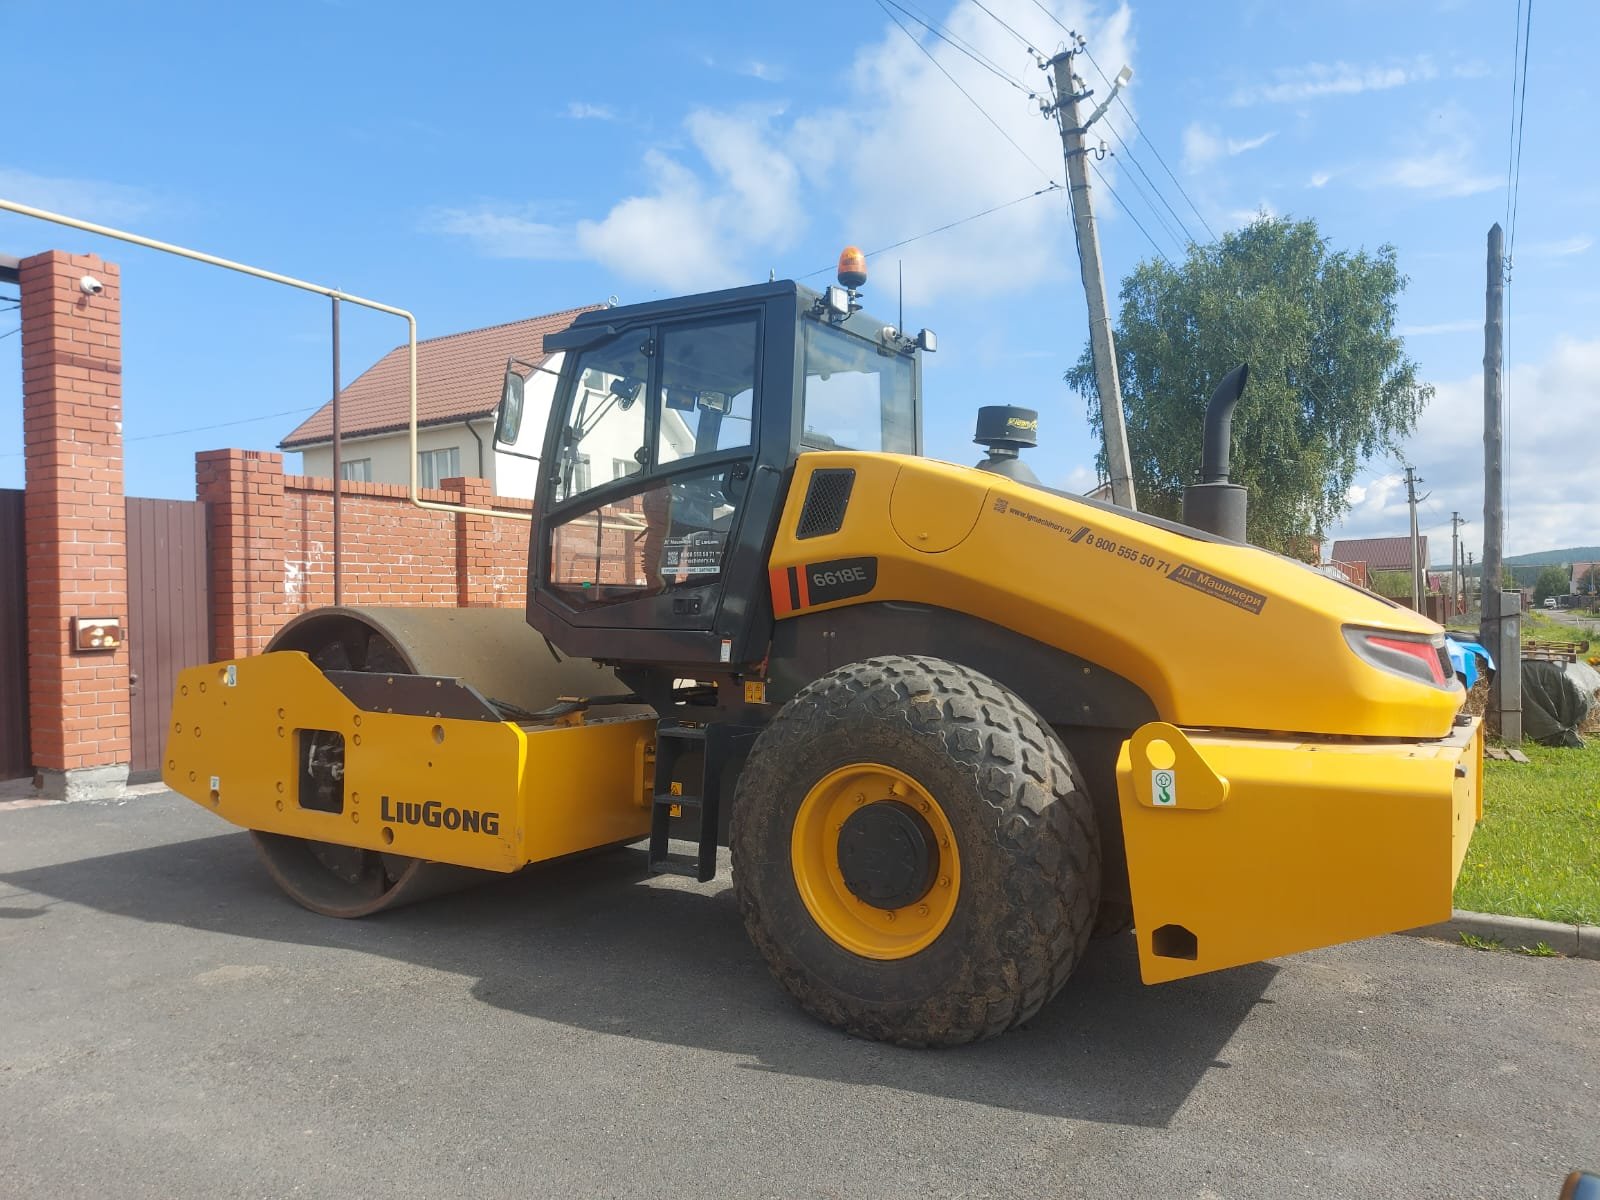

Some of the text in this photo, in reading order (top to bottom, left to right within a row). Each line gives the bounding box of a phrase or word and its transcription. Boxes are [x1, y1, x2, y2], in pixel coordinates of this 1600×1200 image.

[1009, 507, 1073, 535] www.lgmachinery.ru
[1086, 534, 1170, 574] 8 800 555 50 71
[813, 566, 867, 587] 6618E
[1178, 566, 1197, 578] ЛГ
[1197, 573, 1261, 607] Машинери
